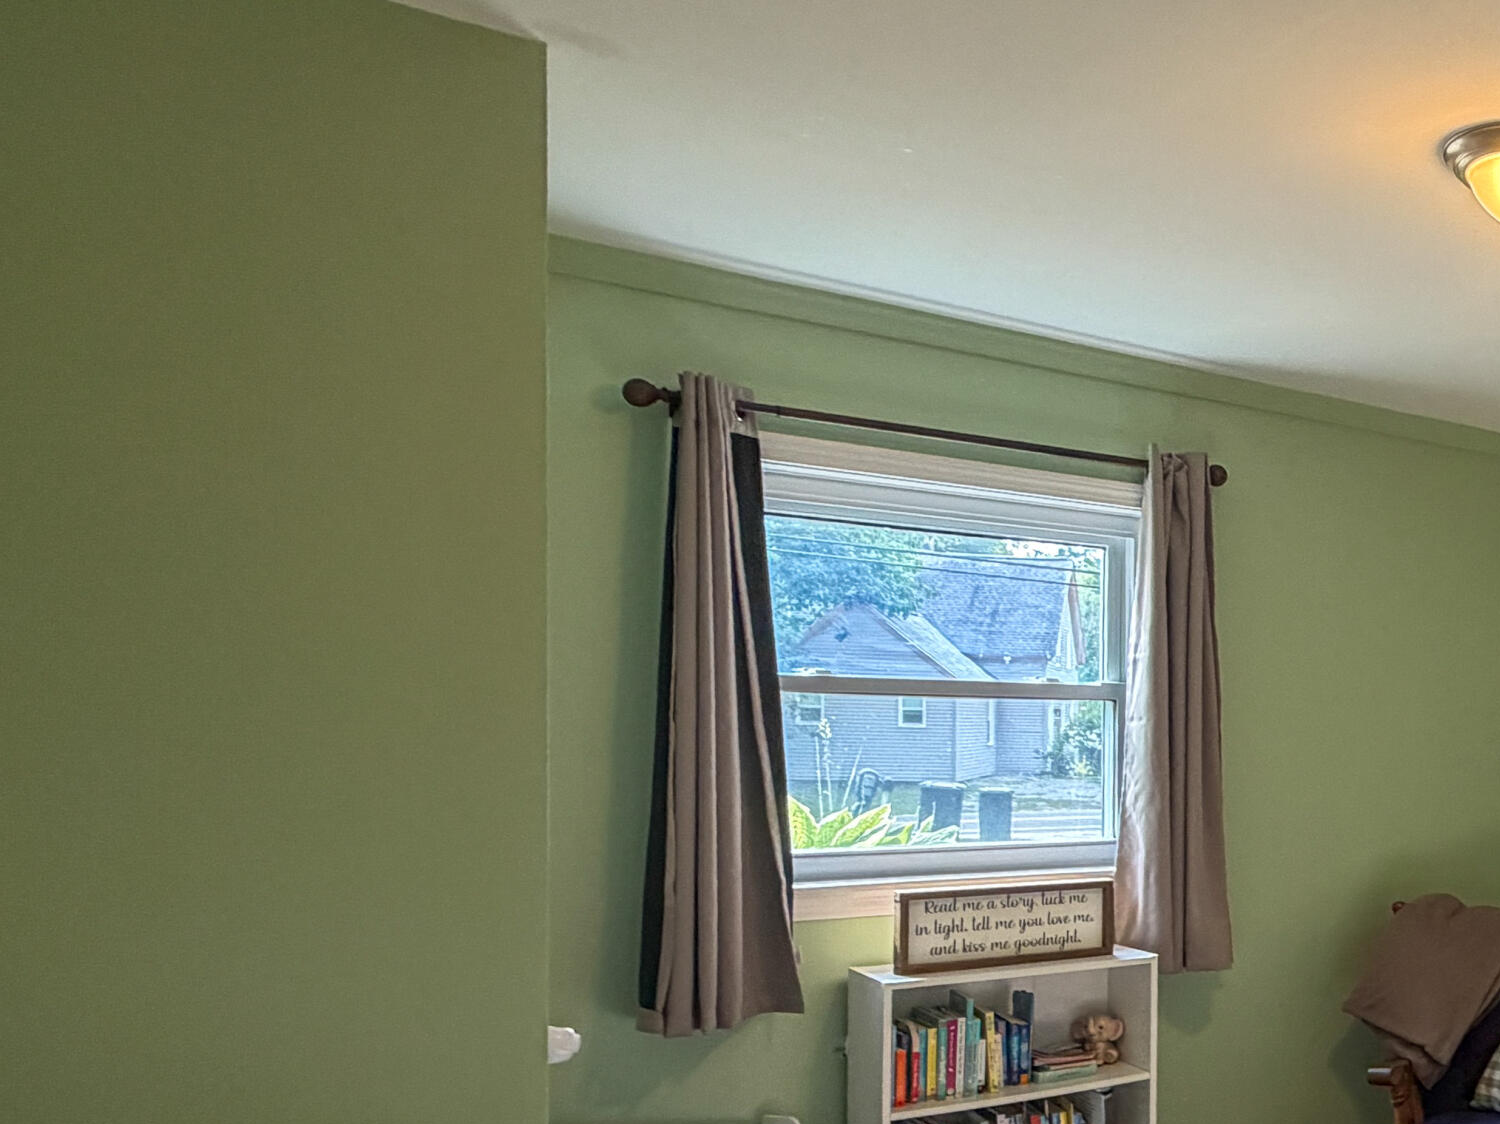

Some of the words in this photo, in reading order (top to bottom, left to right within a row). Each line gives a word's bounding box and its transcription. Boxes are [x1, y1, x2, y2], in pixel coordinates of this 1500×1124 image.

[924, 896, 959, 915] Read
[962, 901, 985, 912] me
[986, 900, 998, 910] a
[1069, 894, 1089, 904] me
[915, 924, 932, 936] in
[995, 919, 1016, 930] me
[1019, 917, 1045, 934] you
[1047, 911, 1071, 926] love
[929, 939, 959, 956] and
[962, 938, 988, 953] kiss
[990, 940, 1011, 951] me
